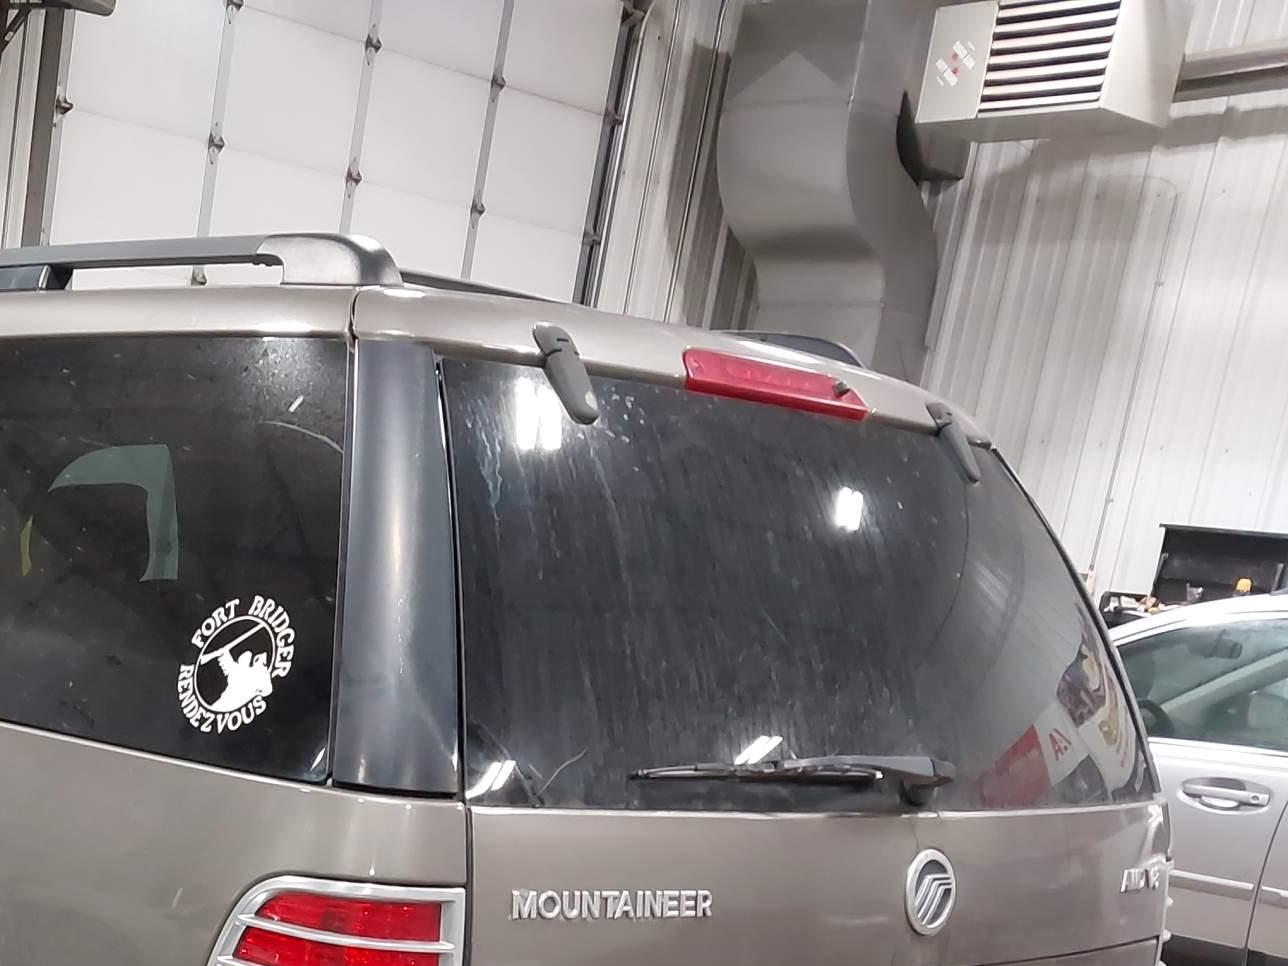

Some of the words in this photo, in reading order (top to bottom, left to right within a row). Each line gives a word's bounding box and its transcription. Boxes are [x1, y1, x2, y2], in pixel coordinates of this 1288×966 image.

[191, 599, 240, 649] FORT
[248, 595, 295, 678] BRIDGER
[178, 664, 267, 734] RENDEZVOUS
[511, 889, 712, 919] MOUNTAINEER
